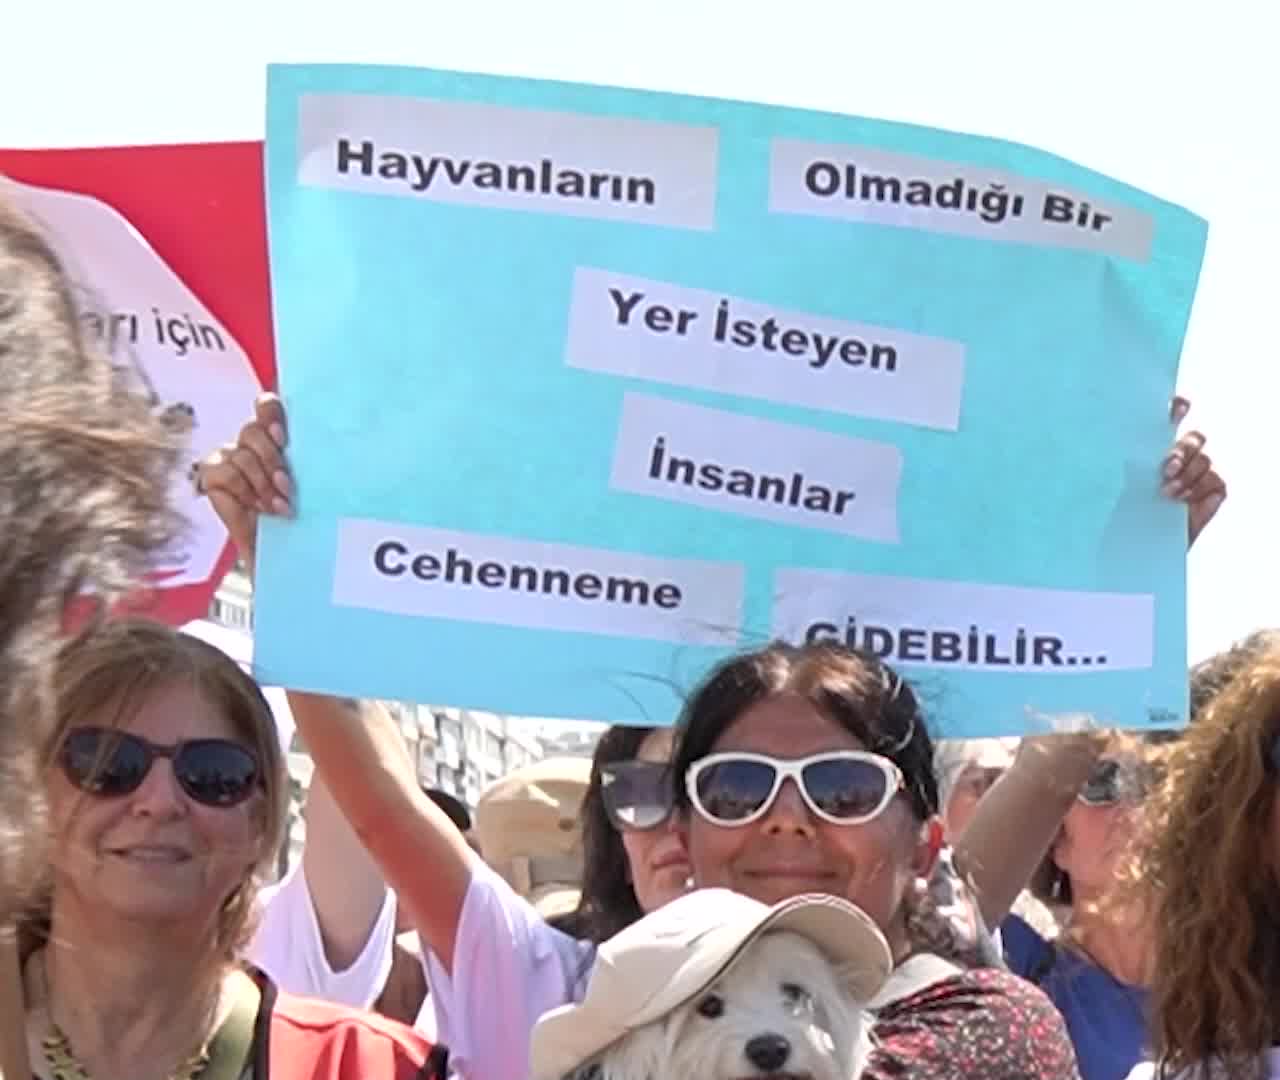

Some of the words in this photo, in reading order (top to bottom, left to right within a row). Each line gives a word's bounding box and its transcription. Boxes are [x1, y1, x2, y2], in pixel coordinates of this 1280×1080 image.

[335, 138, 657, 206] Hayvanların
[804, 160, 1024, 224] Olmadığı
[1042, 192, 1113, 234] Bir
[151, 306, 226, 356] için
[607, 287, 697, 337] Yer
[713, 299, 899, 373] İsteyen
[647, 437, 855, 518] İnsanlar
[373, 540, 683, 611] Cehenneme
[805, 615, 1108, 666] GİDEBİLİR...
